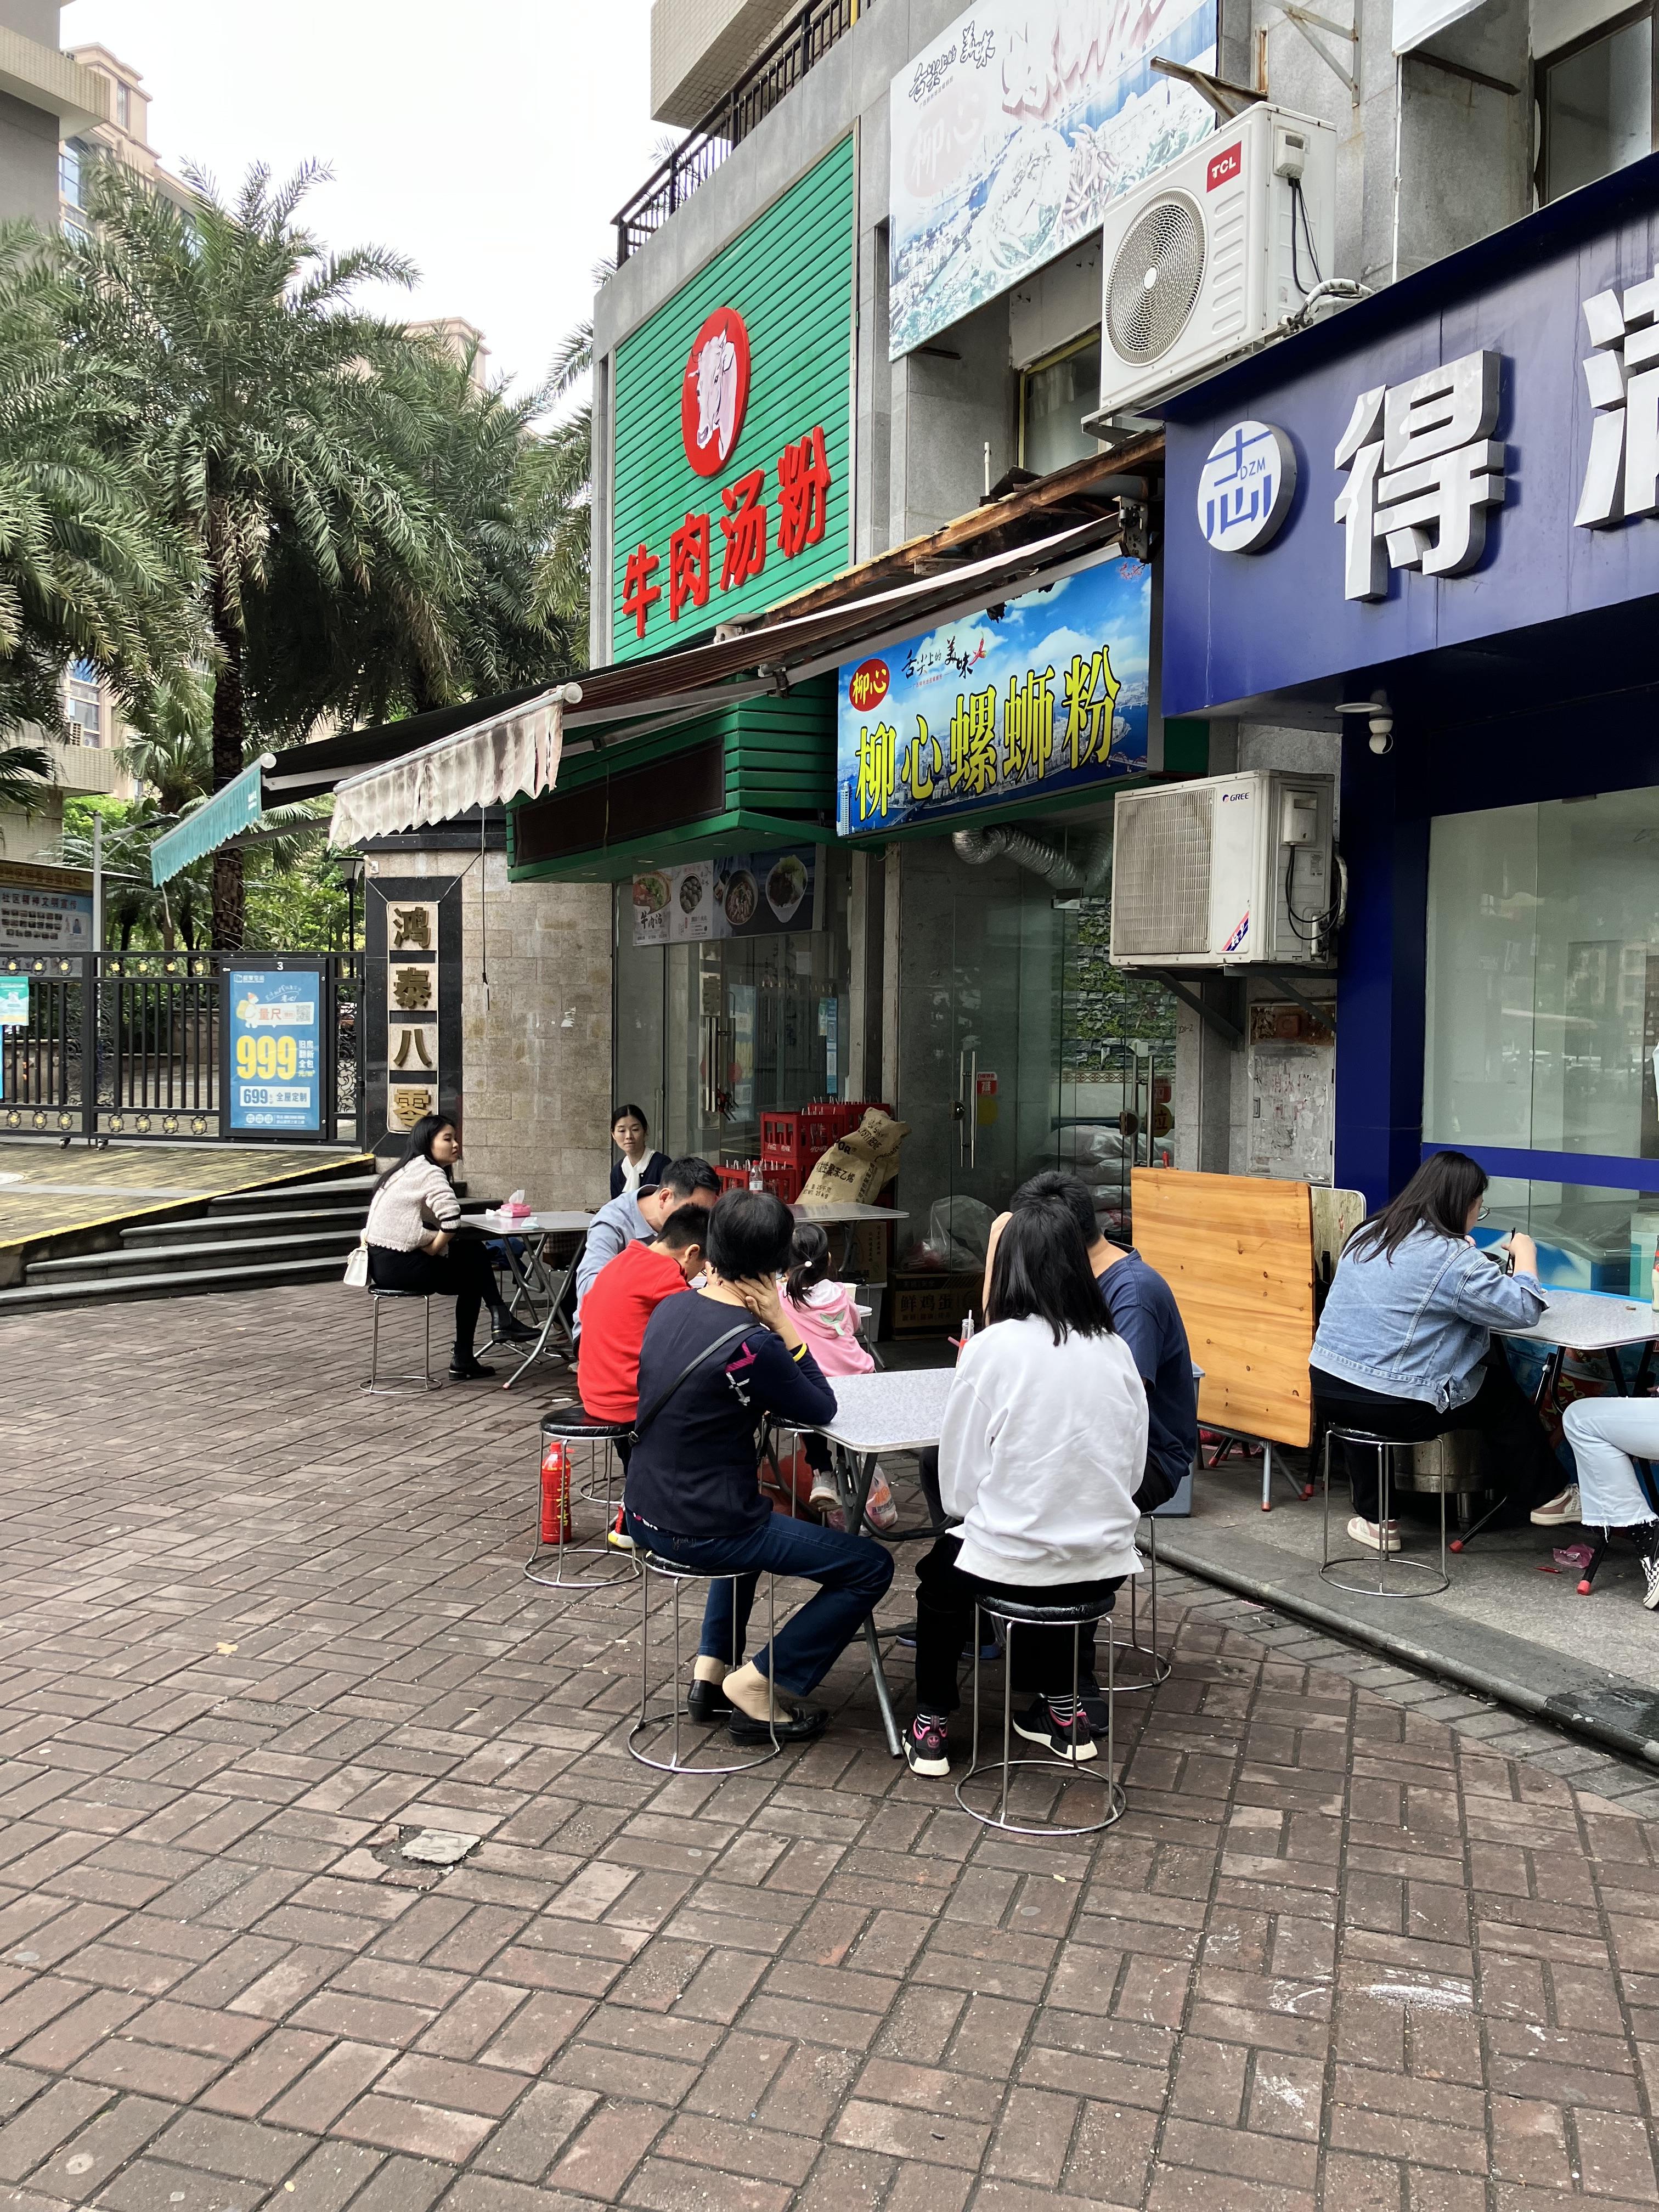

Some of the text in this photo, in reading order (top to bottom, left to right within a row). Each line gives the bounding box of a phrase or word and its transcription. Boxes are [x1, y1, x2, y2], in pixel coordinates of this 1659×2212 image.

[1211, 157, 1237, 180] TCL
[1239, 457, 1266, 481] DZM
[623, 426, 831, 637] 牛肉汤粉
[901, 636, 973, 679] 舌尖上的美味
[853, 669, 888, 706] 柳心
[855, 645, 1121, 821] 柳心螺蛳粉
[1230, 792, 1250, 802] GREE
[2, 893, 78, 910] 社区精神文明宣传
[277, 962, 284, 970] 3
[259, 1008, 281, 1020] 量尺
[393, 907, 431, 1127] 鸿泰八零
[298, 1040, 313, 1049] 旧房
[236, 1035, 297, 1080] 999
[298, 1050, 314, 1059] 翻新
[298, 1059, 313, 1069] 全包
[244, 1088, 268, 1104] 699
[276, 1092, 307, 1102] 全屋定制
[901, 1294, 952, 1312] 鲜鸡蛋
